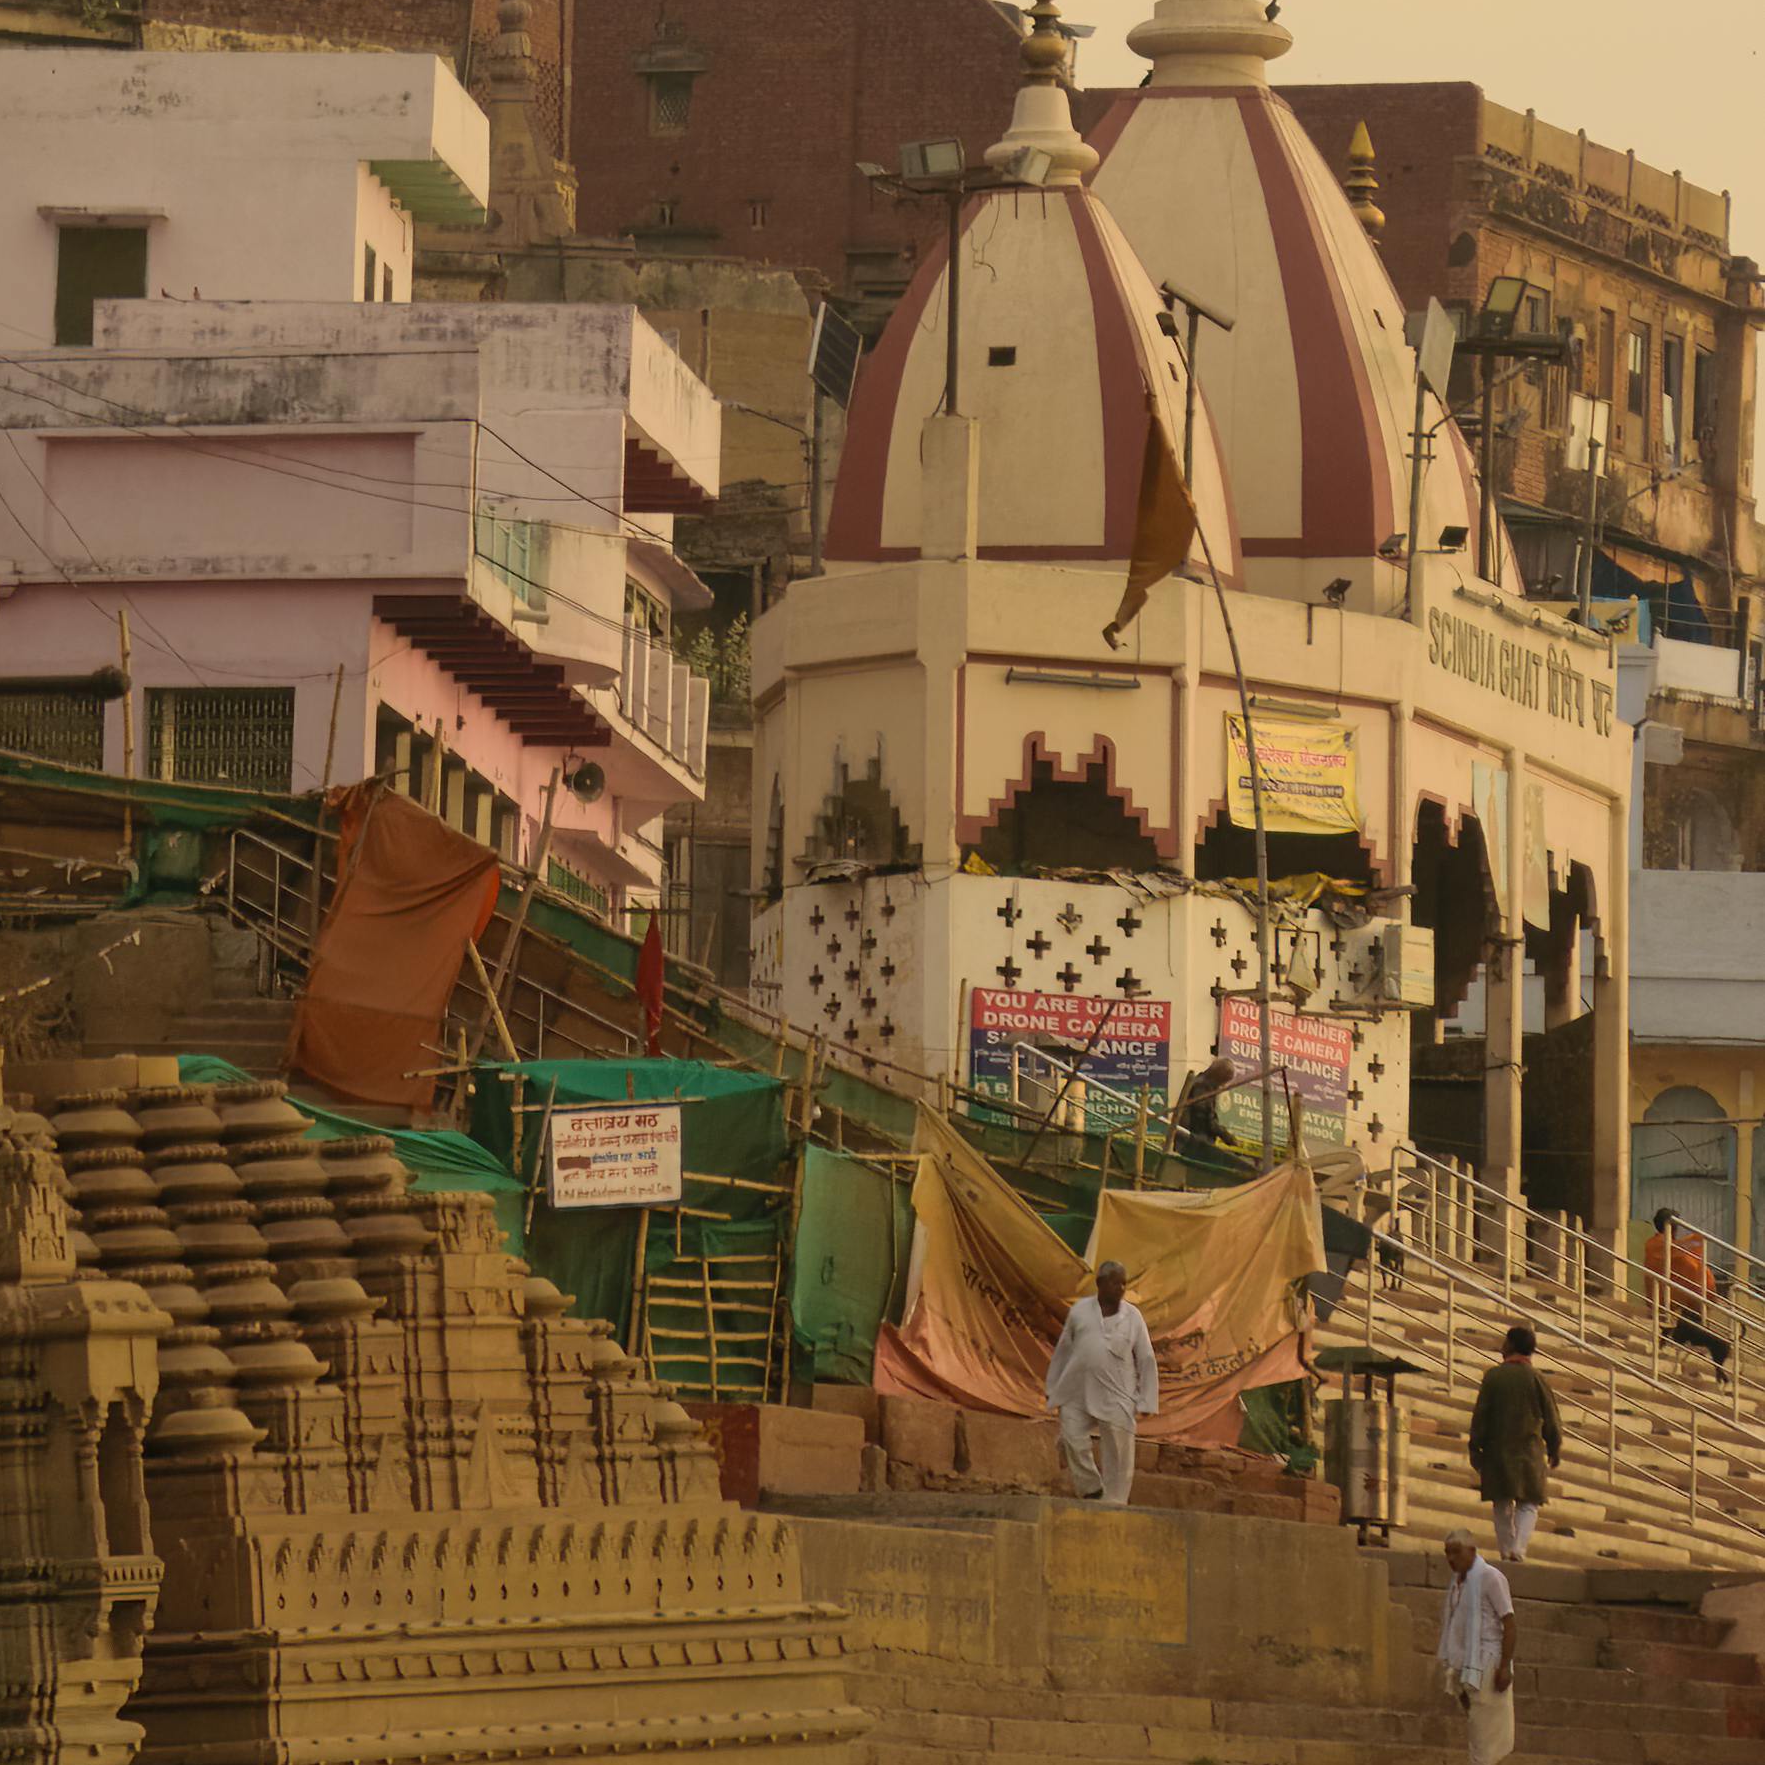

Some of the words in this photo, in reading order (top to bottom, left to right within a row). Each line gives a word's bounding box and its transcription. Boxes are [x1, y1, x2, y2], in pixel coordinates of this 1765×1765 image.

[1428, 606, 1496, 692] SCINDIA
[1499, 639, 1543, 712] GHAT
[981, 991, 1027, 1009] YOU
[1034, 996, 1079, 1013] ARE
[1086, 1000, 1164, 1020] UNDER
[983, 1011, 1060, 1031] DRONE
[1067, 1018, 1161, 1038] CAMERA
[1229, 1001, 1260, 1021] YOU
[1297, 1019, 1347, 1044] UNDER
[1230, 1021, 1280, 1046] DROE
[1283, 1034, 1345, 1064] CAMERA
[1230, 1039, 1342, 1082] SUREILLANCE
